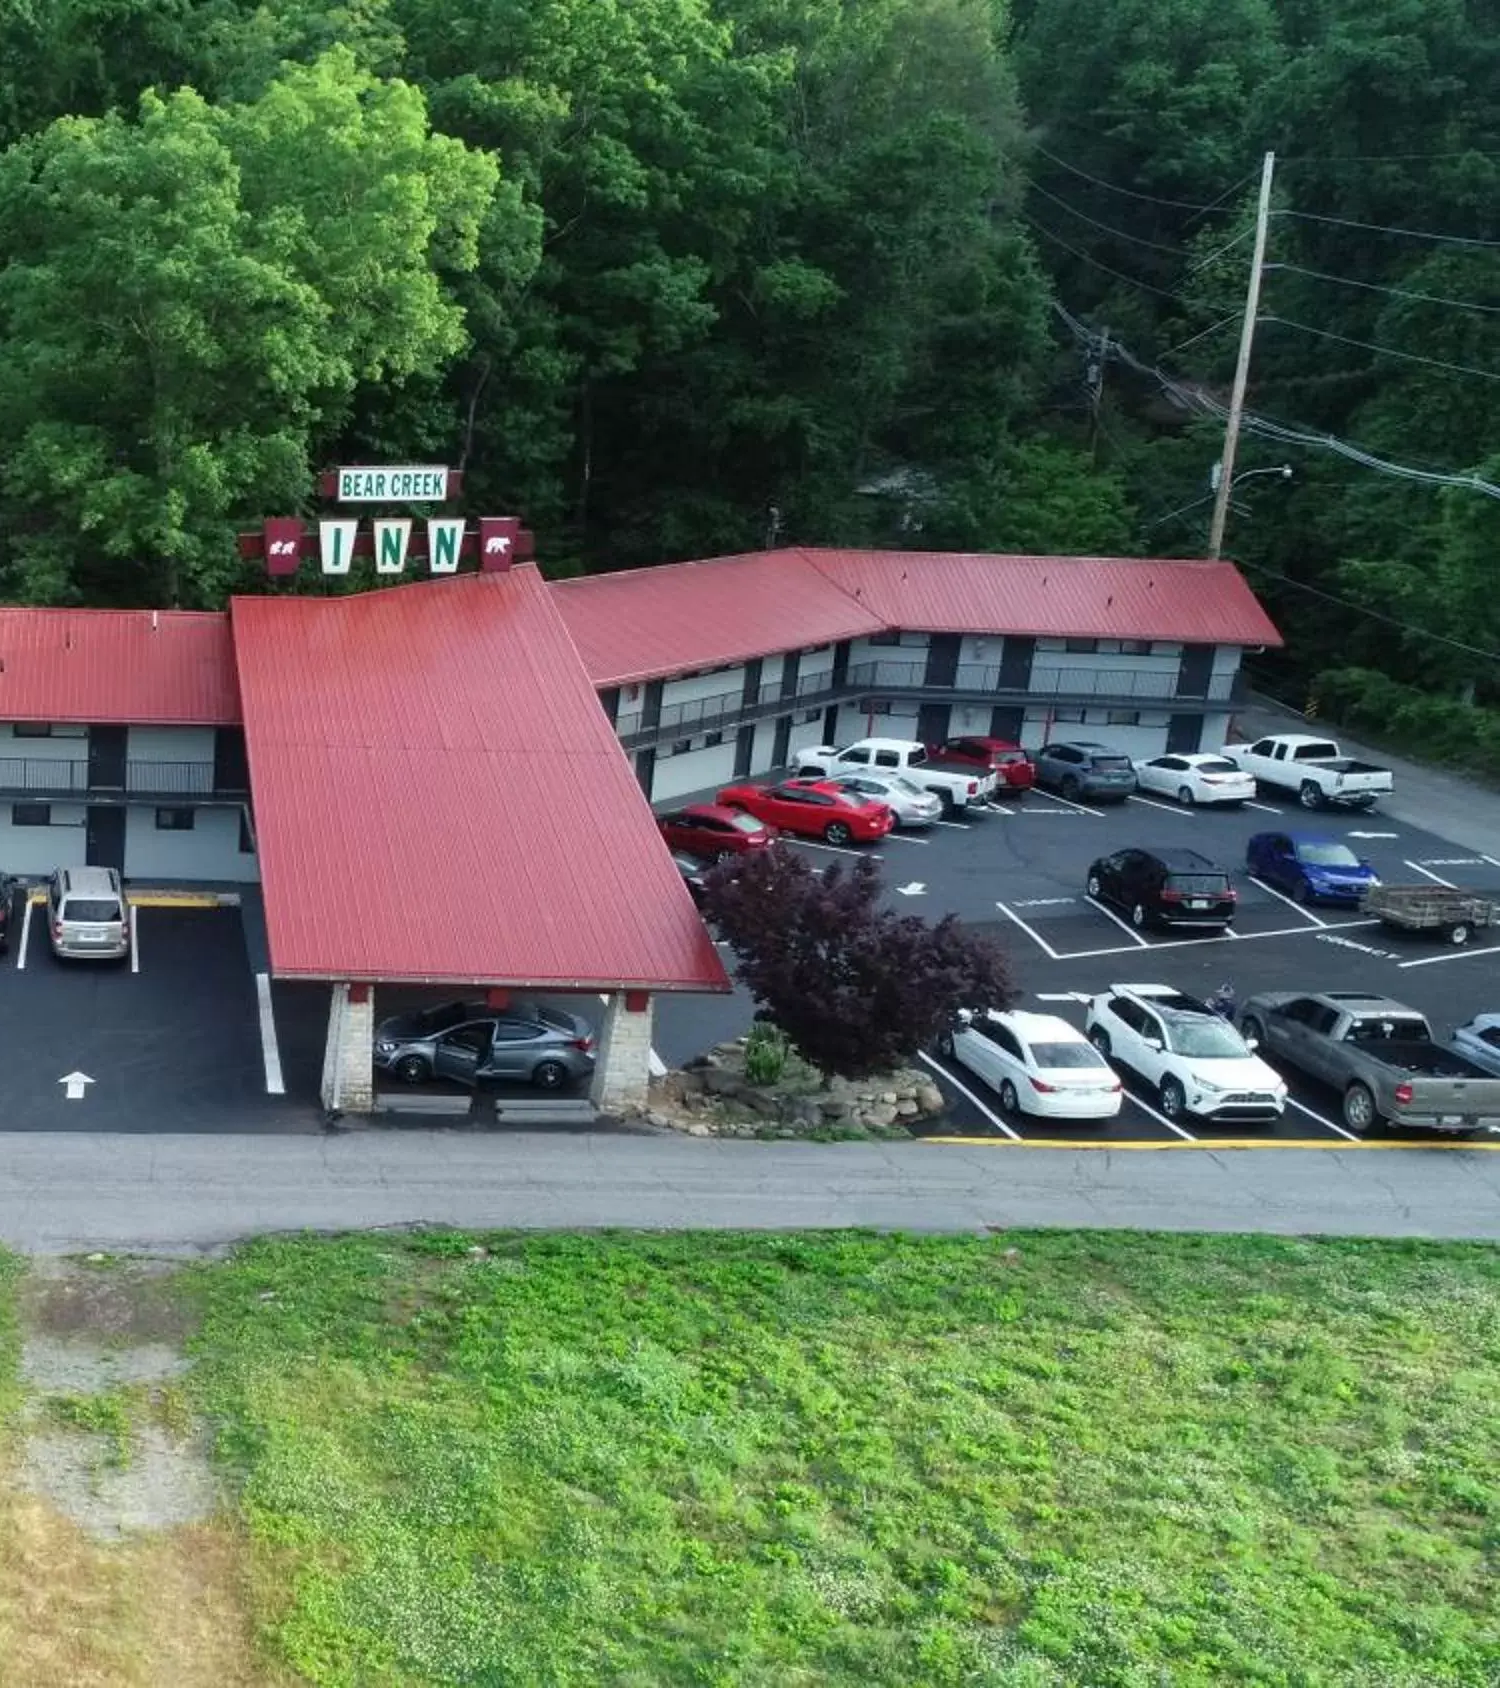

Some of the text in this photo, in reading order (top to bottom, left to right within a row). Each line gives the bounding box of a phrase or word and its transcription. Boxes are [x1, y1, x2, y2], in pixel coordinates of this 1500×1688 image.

[342, 473, 443, 496] BEAR CREEK
[332, 527, 457, 566] INN
